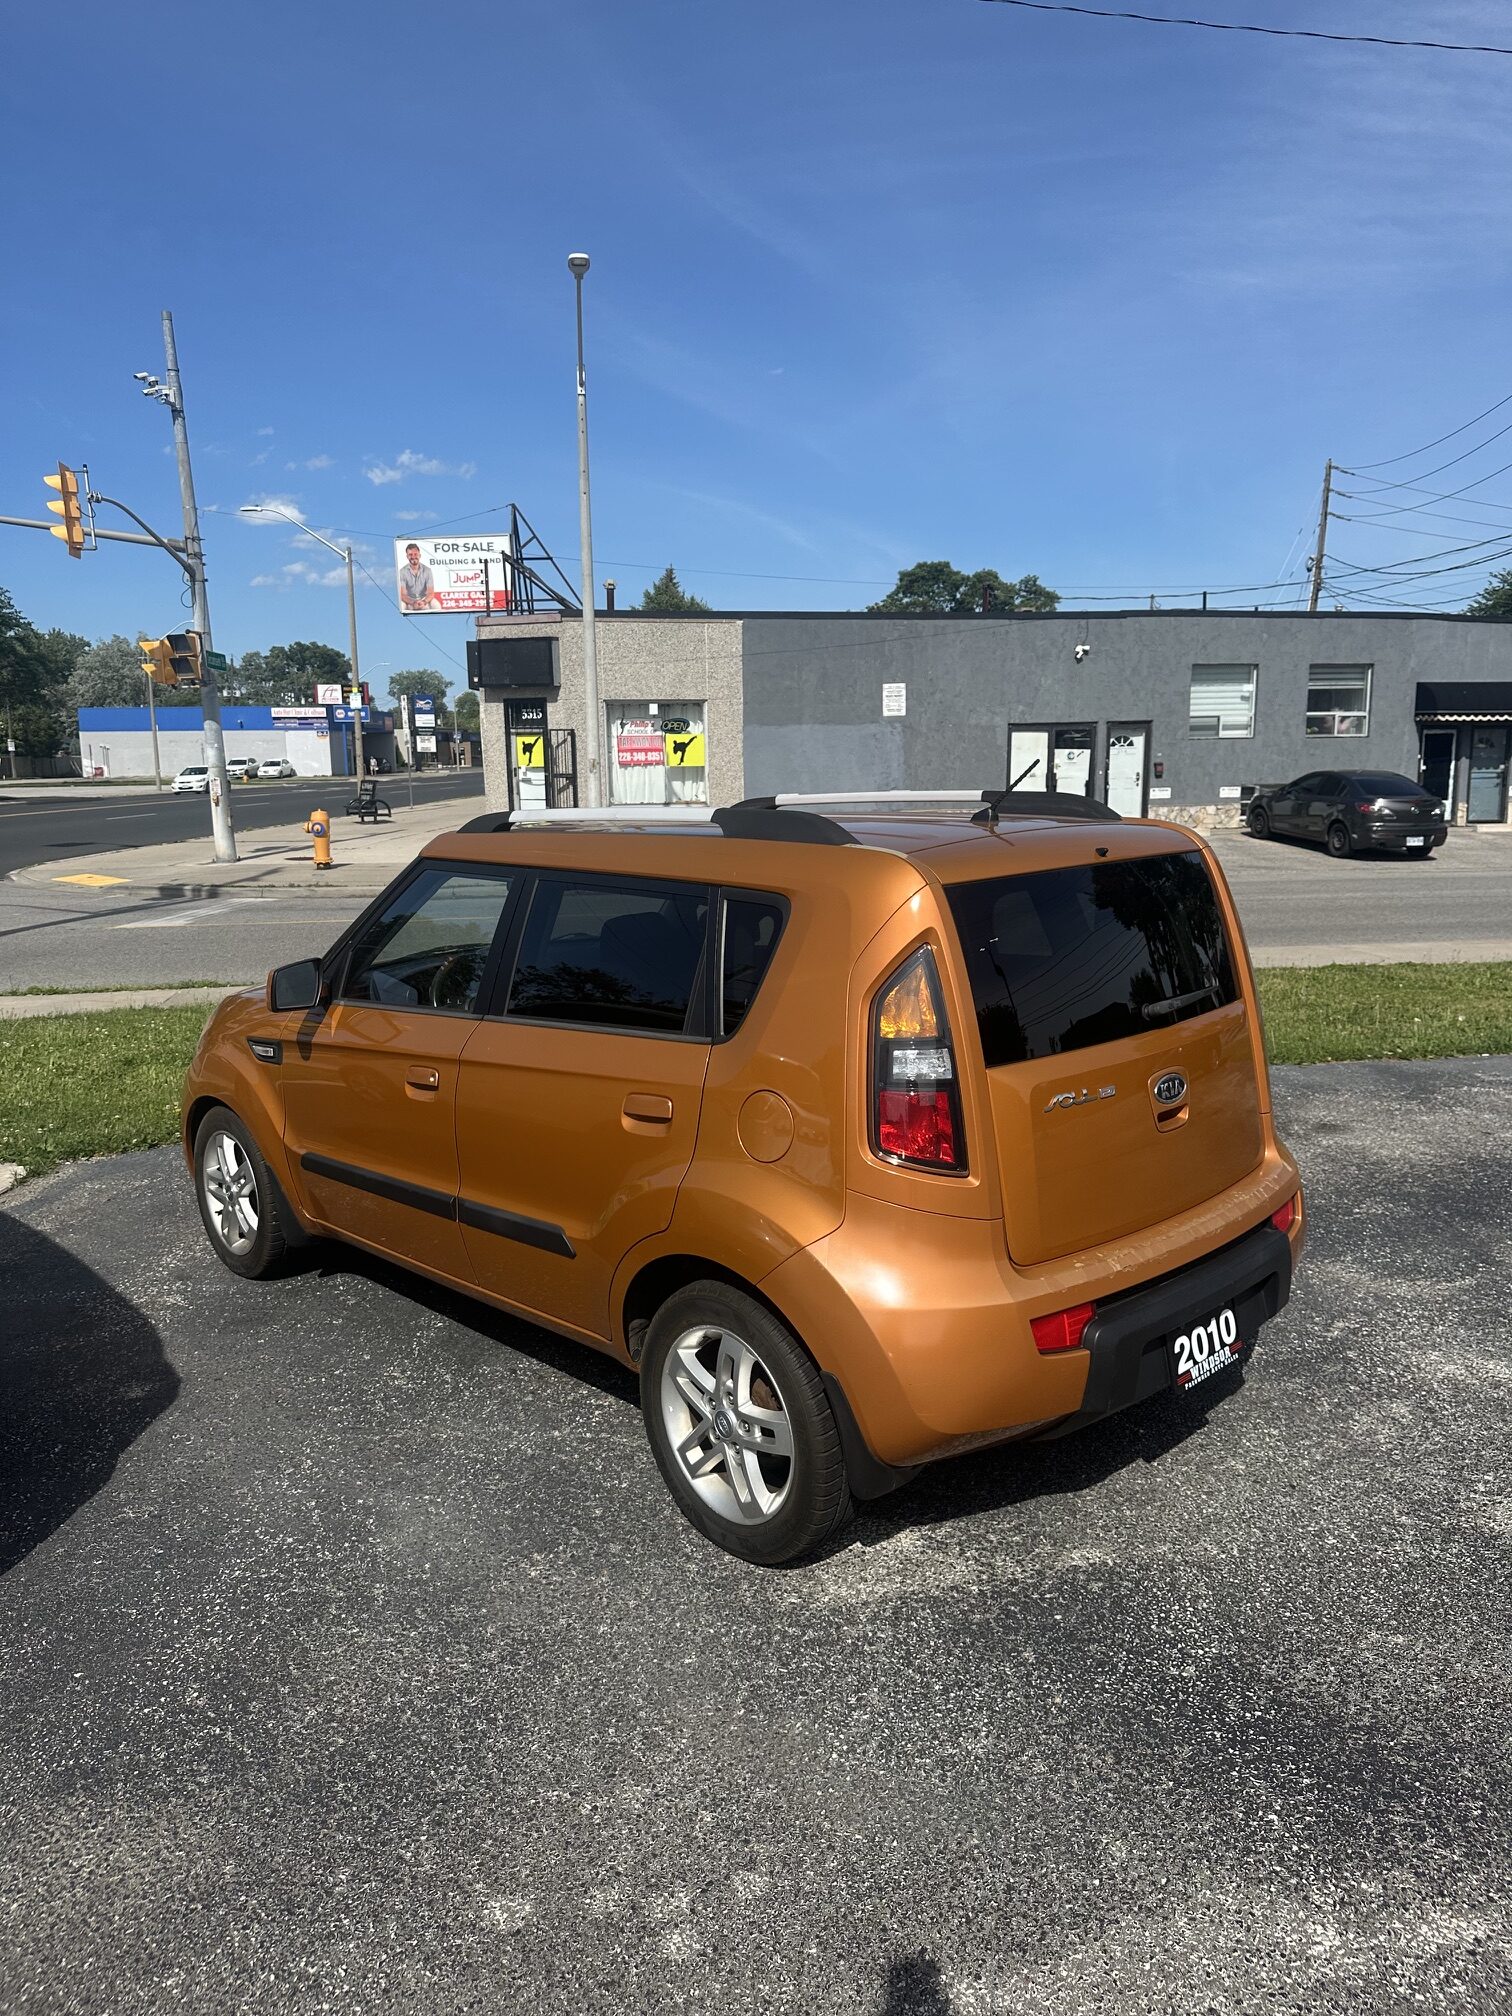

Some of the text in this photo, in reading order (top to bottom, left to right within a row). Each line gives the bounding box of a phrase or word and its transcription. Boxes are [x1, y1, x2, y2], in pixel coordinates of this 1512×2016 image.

[434, 542, 494, 553] FOR SALE
[430, 558, 469, 566] BUILDING
[440, 592, 470, 600] CLARKE
[662, 721, 687, 731] OPEN
[1160, 1079, 1184, 1100] KIA
[1174, 1308, 1237, 1375] 2010
[1189, 1345, 1232, 1380] WINDSOR
[1211, 1362, 1224, 1374] AUTO
[1224, 1353, 1239, 1366] SALES
